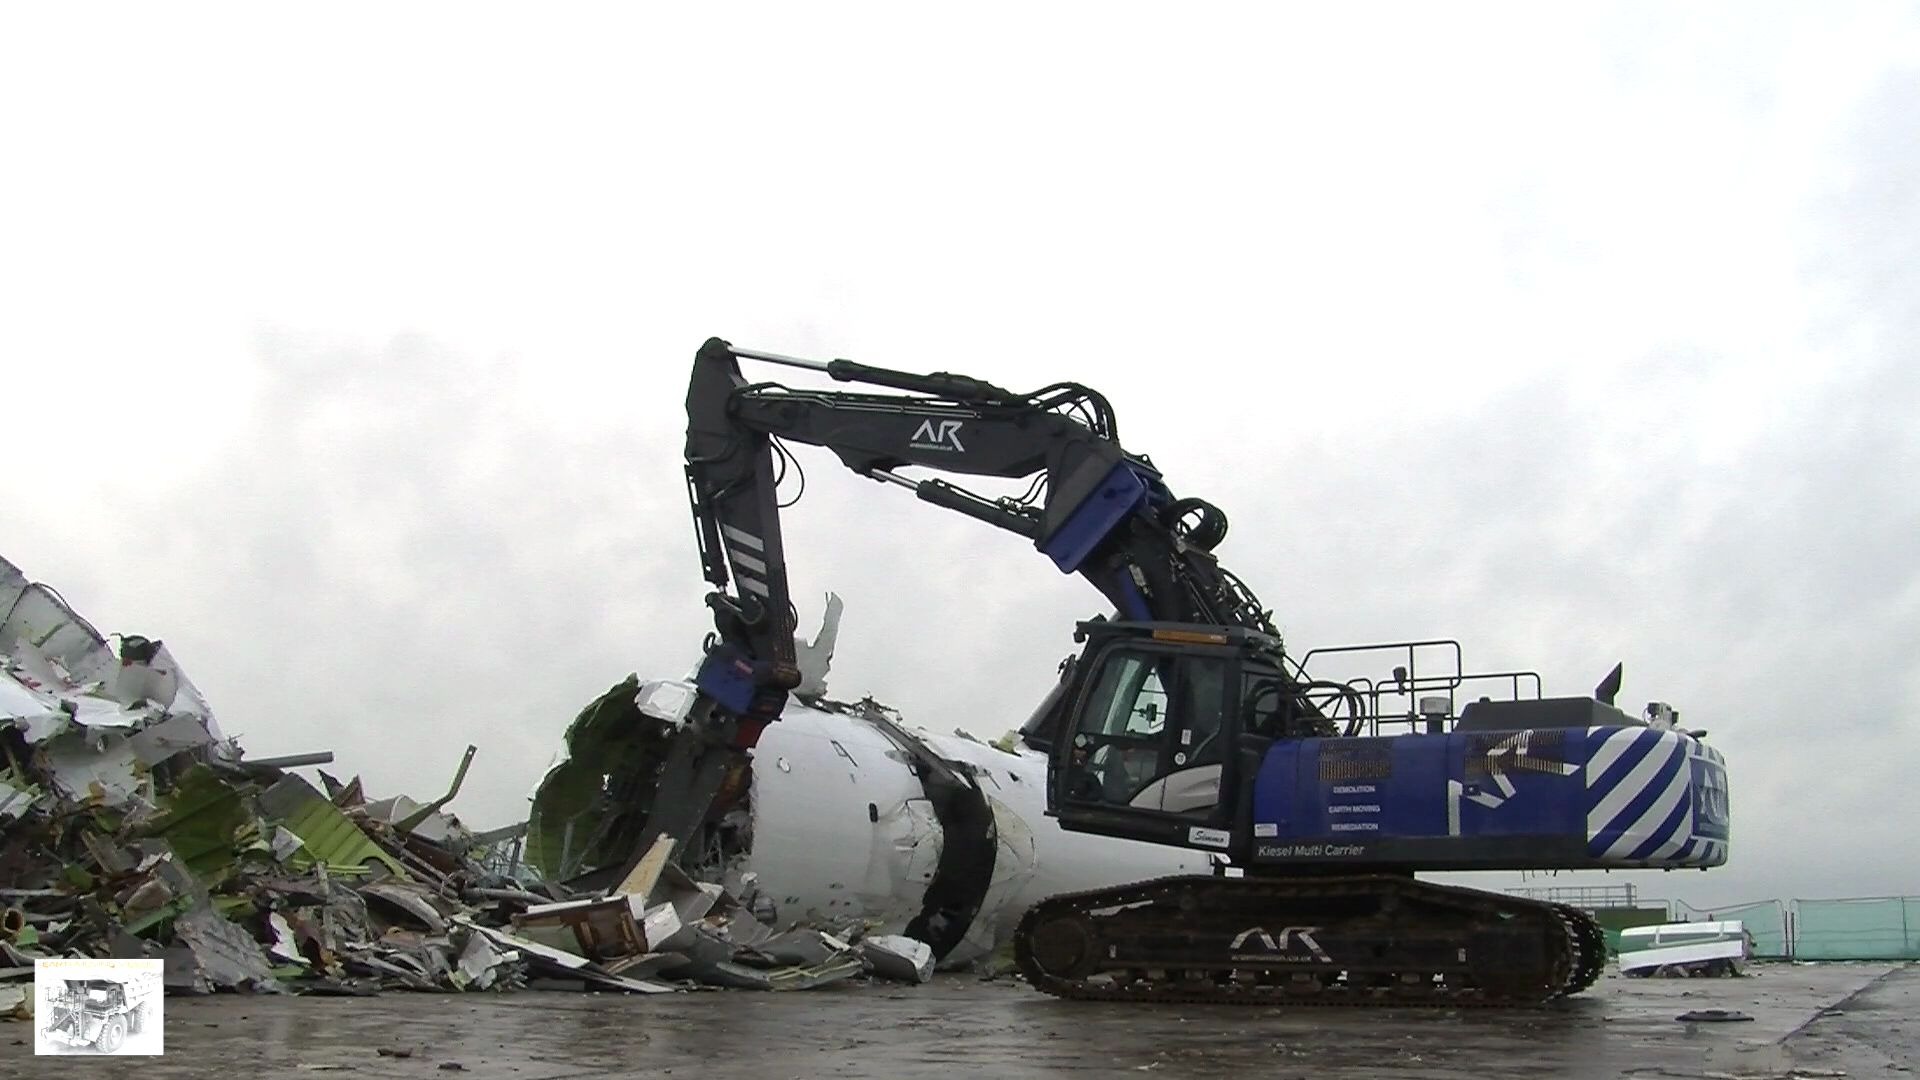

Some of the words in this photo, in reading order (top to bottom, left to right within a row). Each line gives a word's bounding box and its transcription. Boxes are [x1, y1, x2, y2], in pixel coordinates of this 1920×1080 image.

[911, 419, 965, 452] AR
[1333, 785, 1376, 794] DEMOLITION
[1328, 805, 1352, 814] EARTH
[1352, 804, 1381, 813] MOVING
[1331, 823, 1379, 831] REMEDIATION
[1258, 845, 1292, 857] Kiesel
[1294, 845, 1323, 857] Multi
[1325, 844, 1365, 856] Carrier
[1230, 926, 1332, 963] AR
